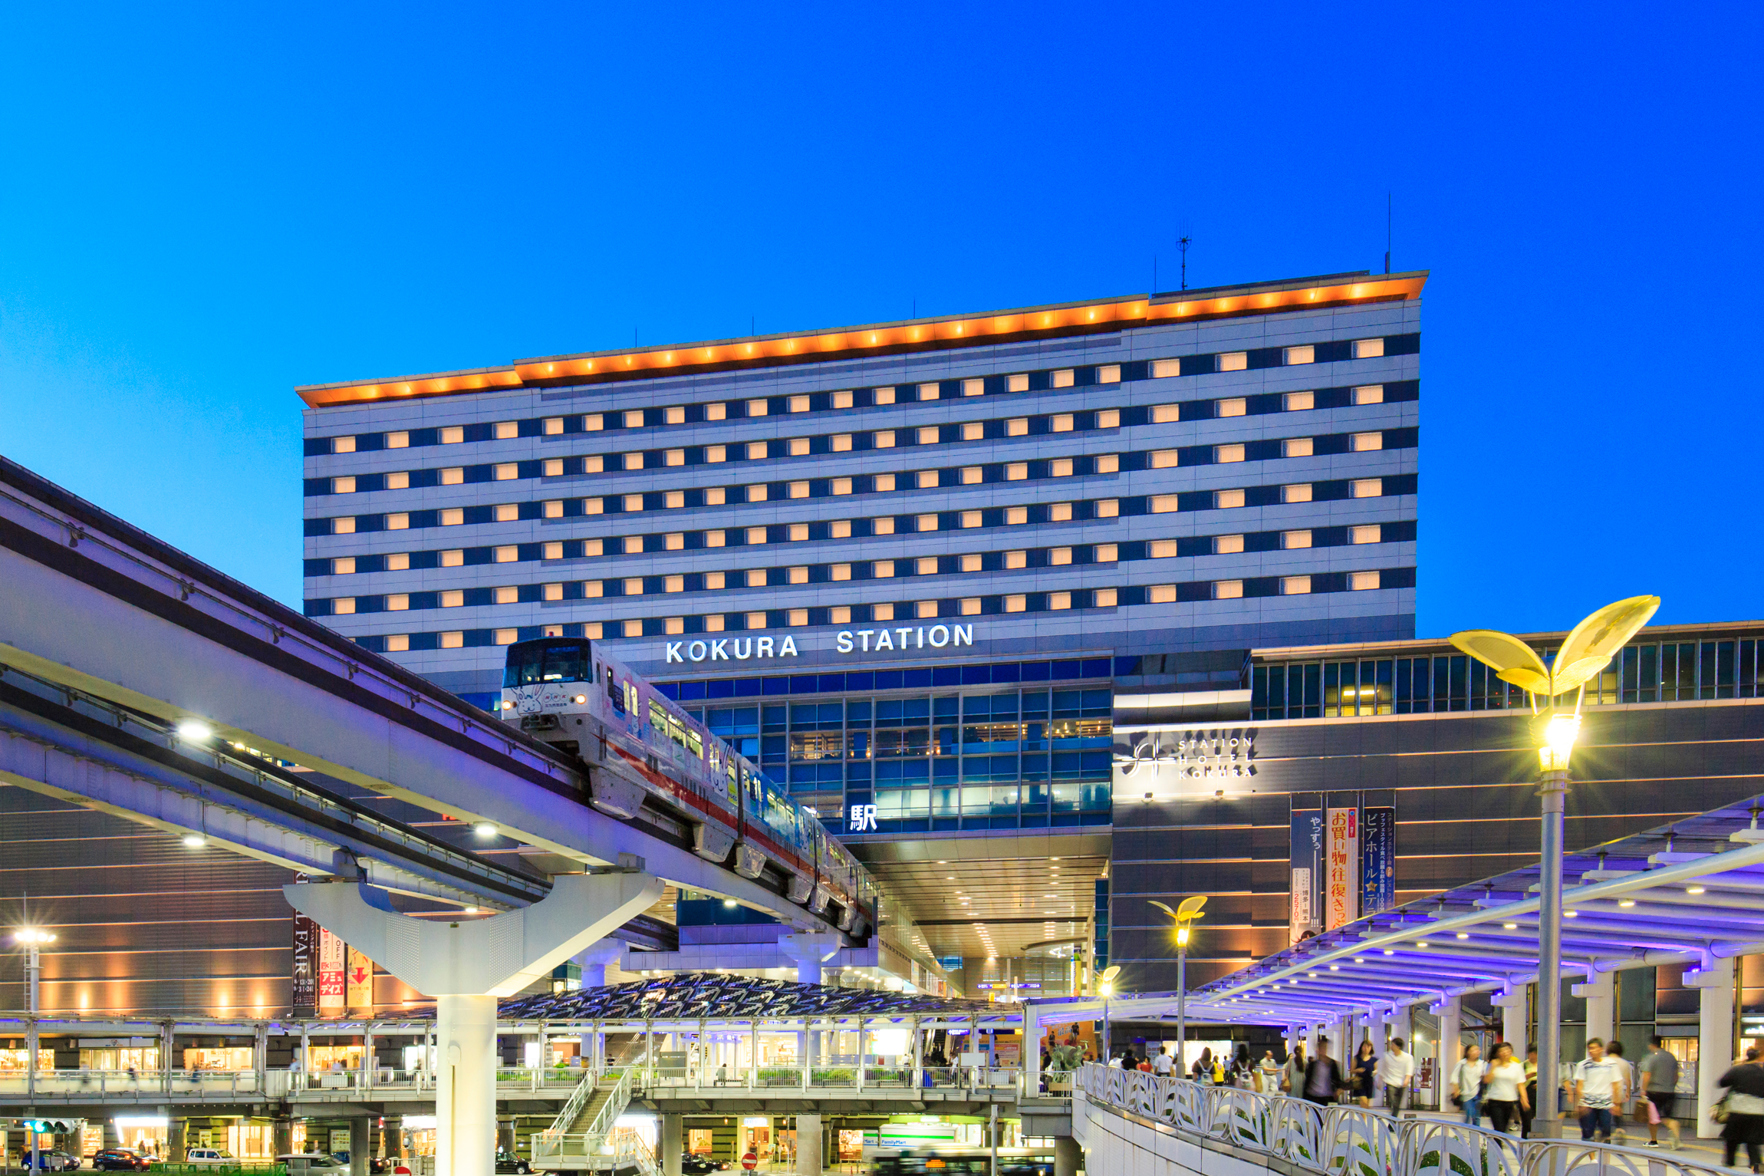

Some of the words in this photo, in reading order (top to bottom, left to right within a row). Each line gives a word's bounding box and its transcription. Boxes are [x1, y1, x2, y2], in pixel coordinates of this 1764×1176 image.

[666, 635, 798, 663] KOKURA
[836, 623, 974, 653] STATION
[1178, 737, 1252, 749] STATION
[1178, 754, 1252, 765] HOTEL
[1178, 767, 1253, 780] KOKURA
[850, 803, 878, 832] 駅
[295, 930, 308, 974] FAIR
